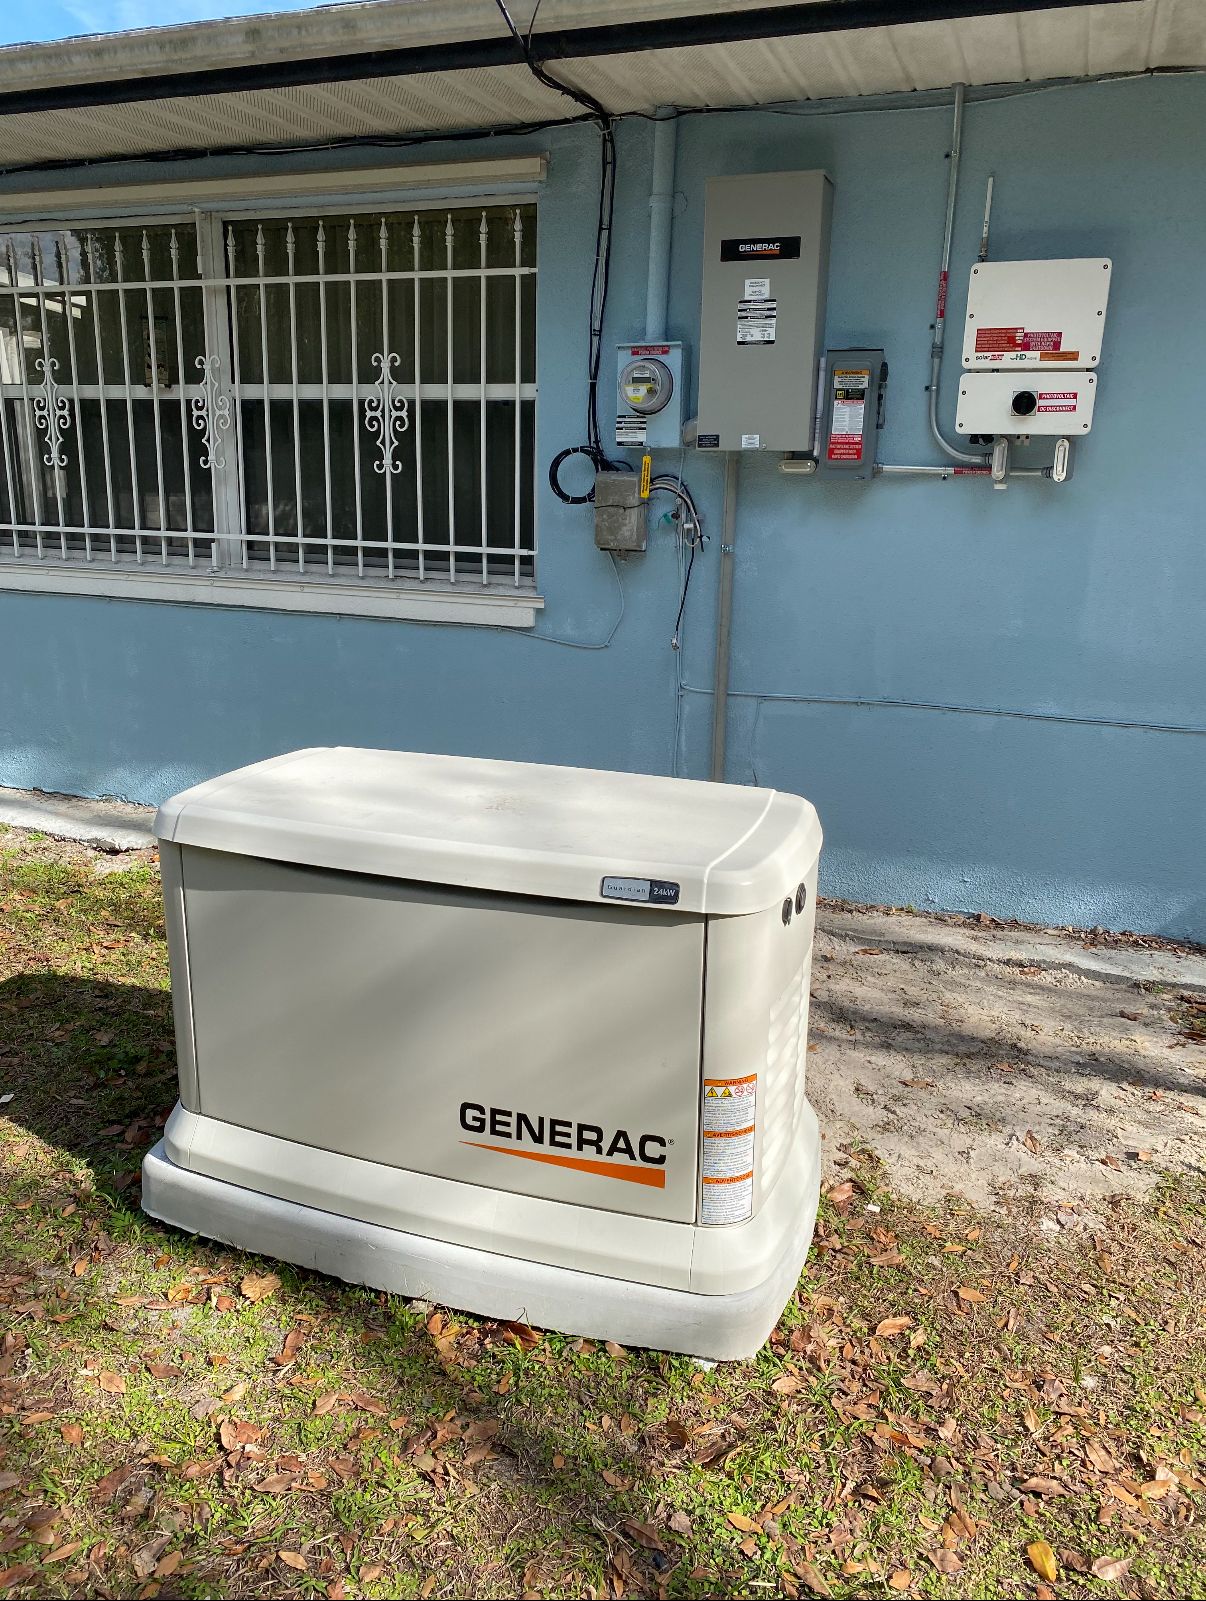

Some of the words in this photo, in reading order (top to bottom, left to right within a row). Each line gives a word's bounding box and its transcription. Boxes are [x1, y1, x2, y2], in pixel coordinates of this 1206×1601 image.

[739, 243, 780, 251] GENERAC
[607, 884, 646, 893] Guardian
[653, 887, 676, 897] 24kW
